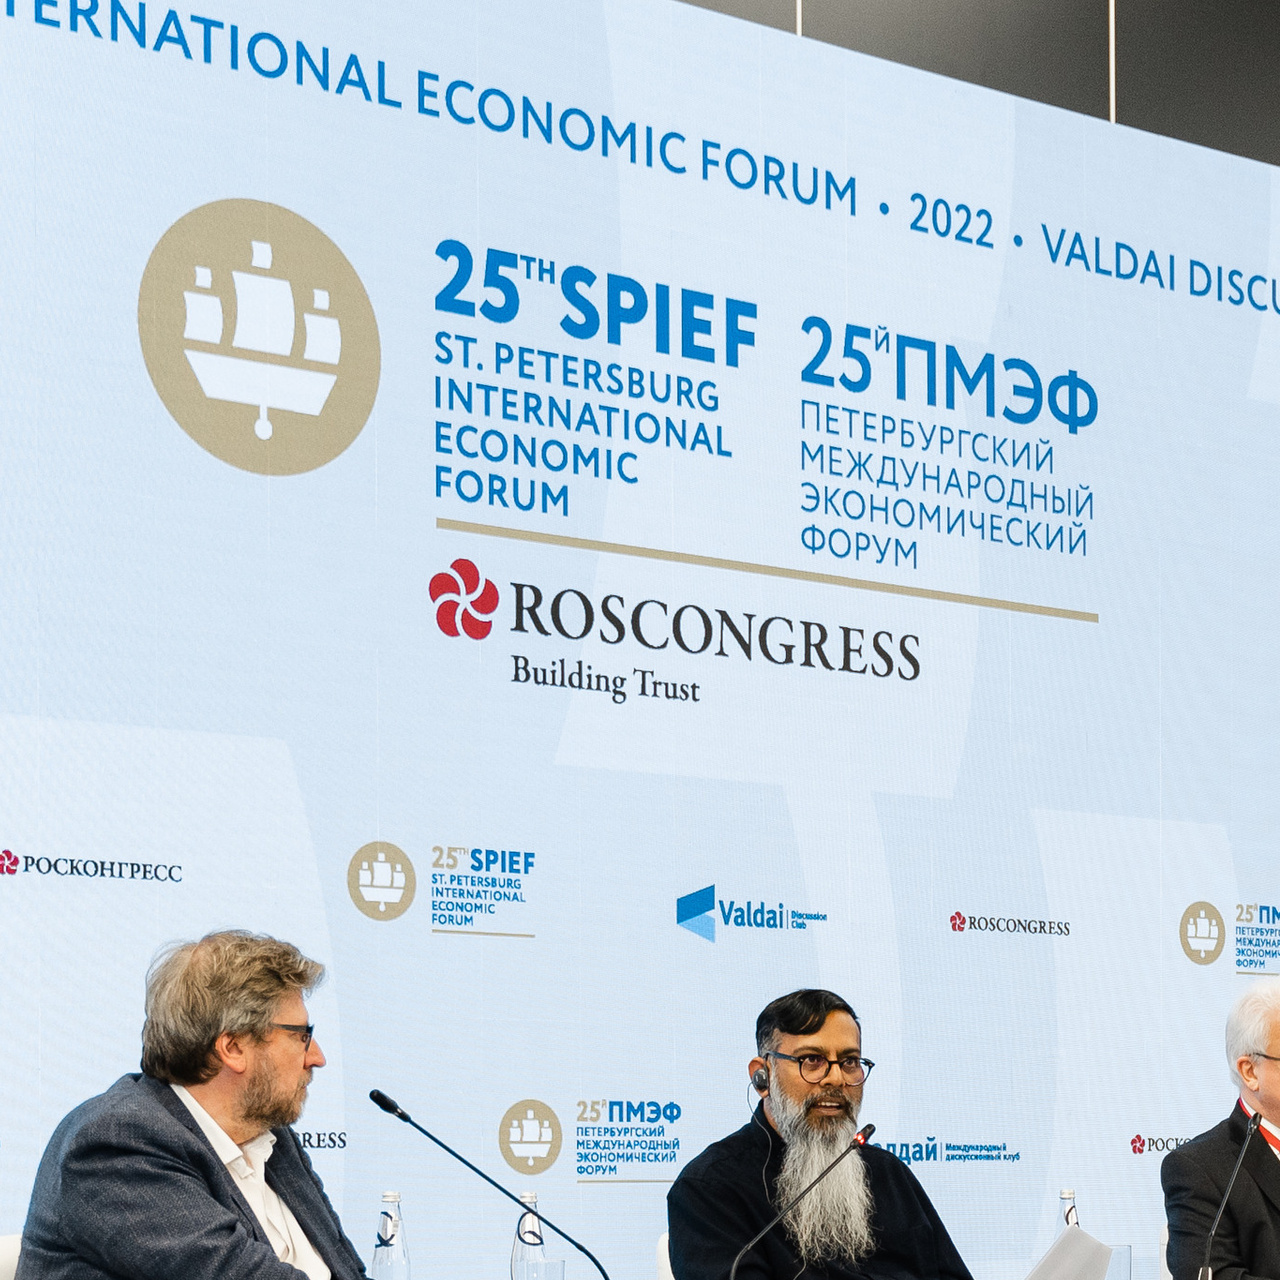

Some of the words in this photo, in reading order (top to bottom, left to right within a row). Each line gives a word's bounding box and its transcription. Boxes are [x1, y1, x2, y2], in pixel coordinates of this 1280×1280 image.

[6, 0, 402, 108] ERNATIONAL
[417, 70, 687, 174] ECONOMIC
[702, 139, 857, 216] FORUM
[910, 193, 994, 249] 2022
[1042, 223, 1175, 291] VALDAI
[560, 266, 757, 368] SPIEF
[434, 332, 484, 371] ST.
[495, 345, 720, 413] PETERSBURG
[896, 334, 1099, 434] ПМЭФ
[435, 376, 733, 458] INTERNATIONAL
[800, 400, 1054, 474] ПЕТЕРБУРГСКИЙ
[435, 421, 639, 484] ECONOMIC
[435, 465, 570, 516] FORUM
[800, 440, 1095, 520] МЕЖДУНАРОДНЫЙ
[800, 482, 1087, 556] ЭКОНОМИЧЕСКИЙ
[800, 525, 918, 570] ФОРУМ
[510, 582, 921, 681] ROSCONGRESS
[510, 656, 627, 705] Building
[634, 668, 700, 703] Trust
[23, 854, 183, 883] РОСКОНГРЕСС
[470, 848, 535, 875] SPIEF
[431, 873, 447, 885] ST.
[449, 874, 521, 889] PETERSBURG
[431, 886, 526, 903] INTERNATIONAL
[431, 900, 495, 914] ECONOMIC
[431, 913, 474, 926] FORUM
[718, 899, 784, 929] Valdai
[791, 920, 807, 930] Club
[969, 915, 1071, 937] ROSCONGRESS
[1235, 958, 1266, 969] ФОРУМ
[608, 1100, 682, 1124] ПМЭФ
[576, 1125, 665, 1137] ПЕТЕРБУРГСКИЙ
[576, 1138, 680, 1151] МЕЖДУНАРОДНЫЙ
[576, 1151, 677, 1163] ЭКОНОМИЧЕСКИЙ
[576, 1164, 617, 1175] ФОРУМ
[1003, 1152, 1020, 1162] клуб
